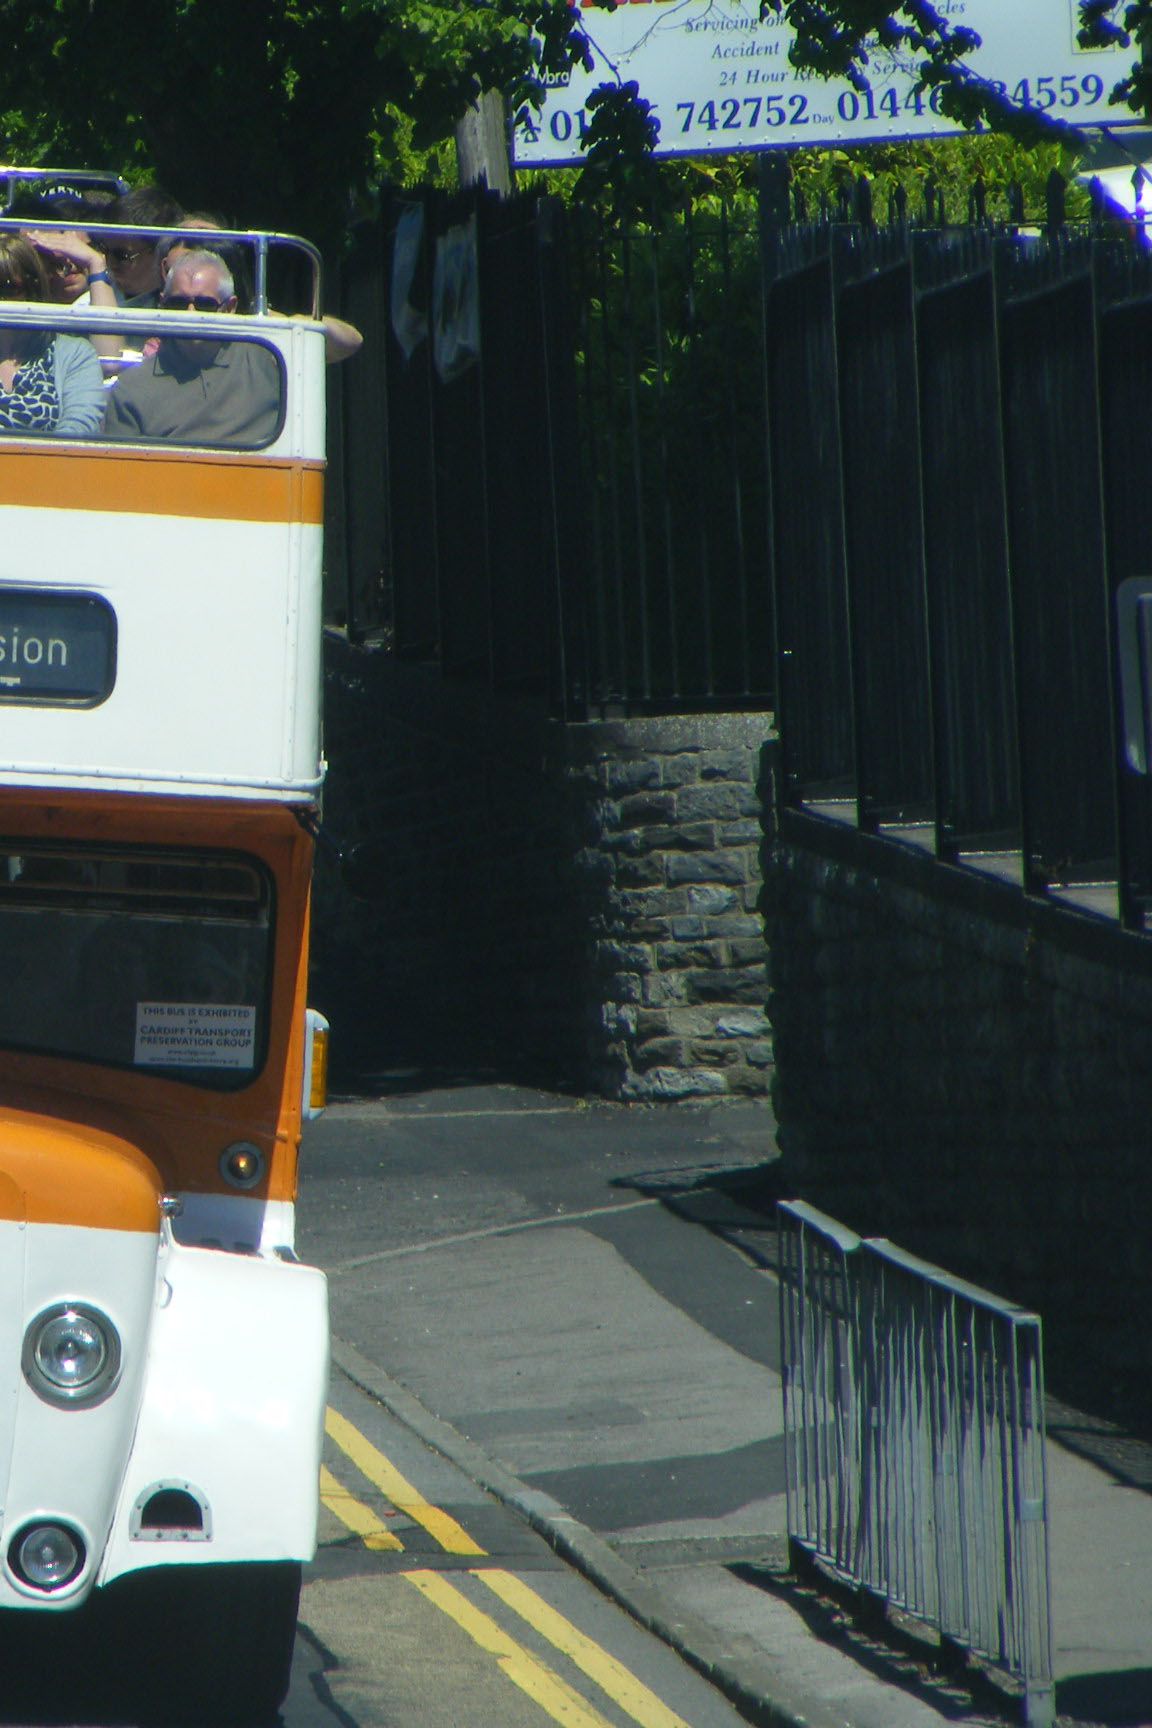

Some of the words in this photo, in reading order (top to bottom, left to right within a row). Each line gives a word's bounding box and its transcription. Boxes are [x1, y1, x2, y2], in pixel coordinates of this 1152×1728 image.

[685, 15, 759, 34] Servicing
[711, 40, 780, 59] Accident
[719, 71, 738, 87] 24
[746, 70, 789, 85] Hour
[676, 94, 810, 132] 742752
[813, 113, 835, 126] Day
[143, 1007, 164, 1016] THIS
[166, 1007, 185, 1017] BUS
[198, 1008, 251, 1018] EXHIBITED
[140, 1025, 186, 1036] CARDIFF
[189, 1026, 252, 1037] TRANSPORT
[140, 1035, 214, 1047] PRESERVATION
[215, 1038, 252, 1048] GROUP
